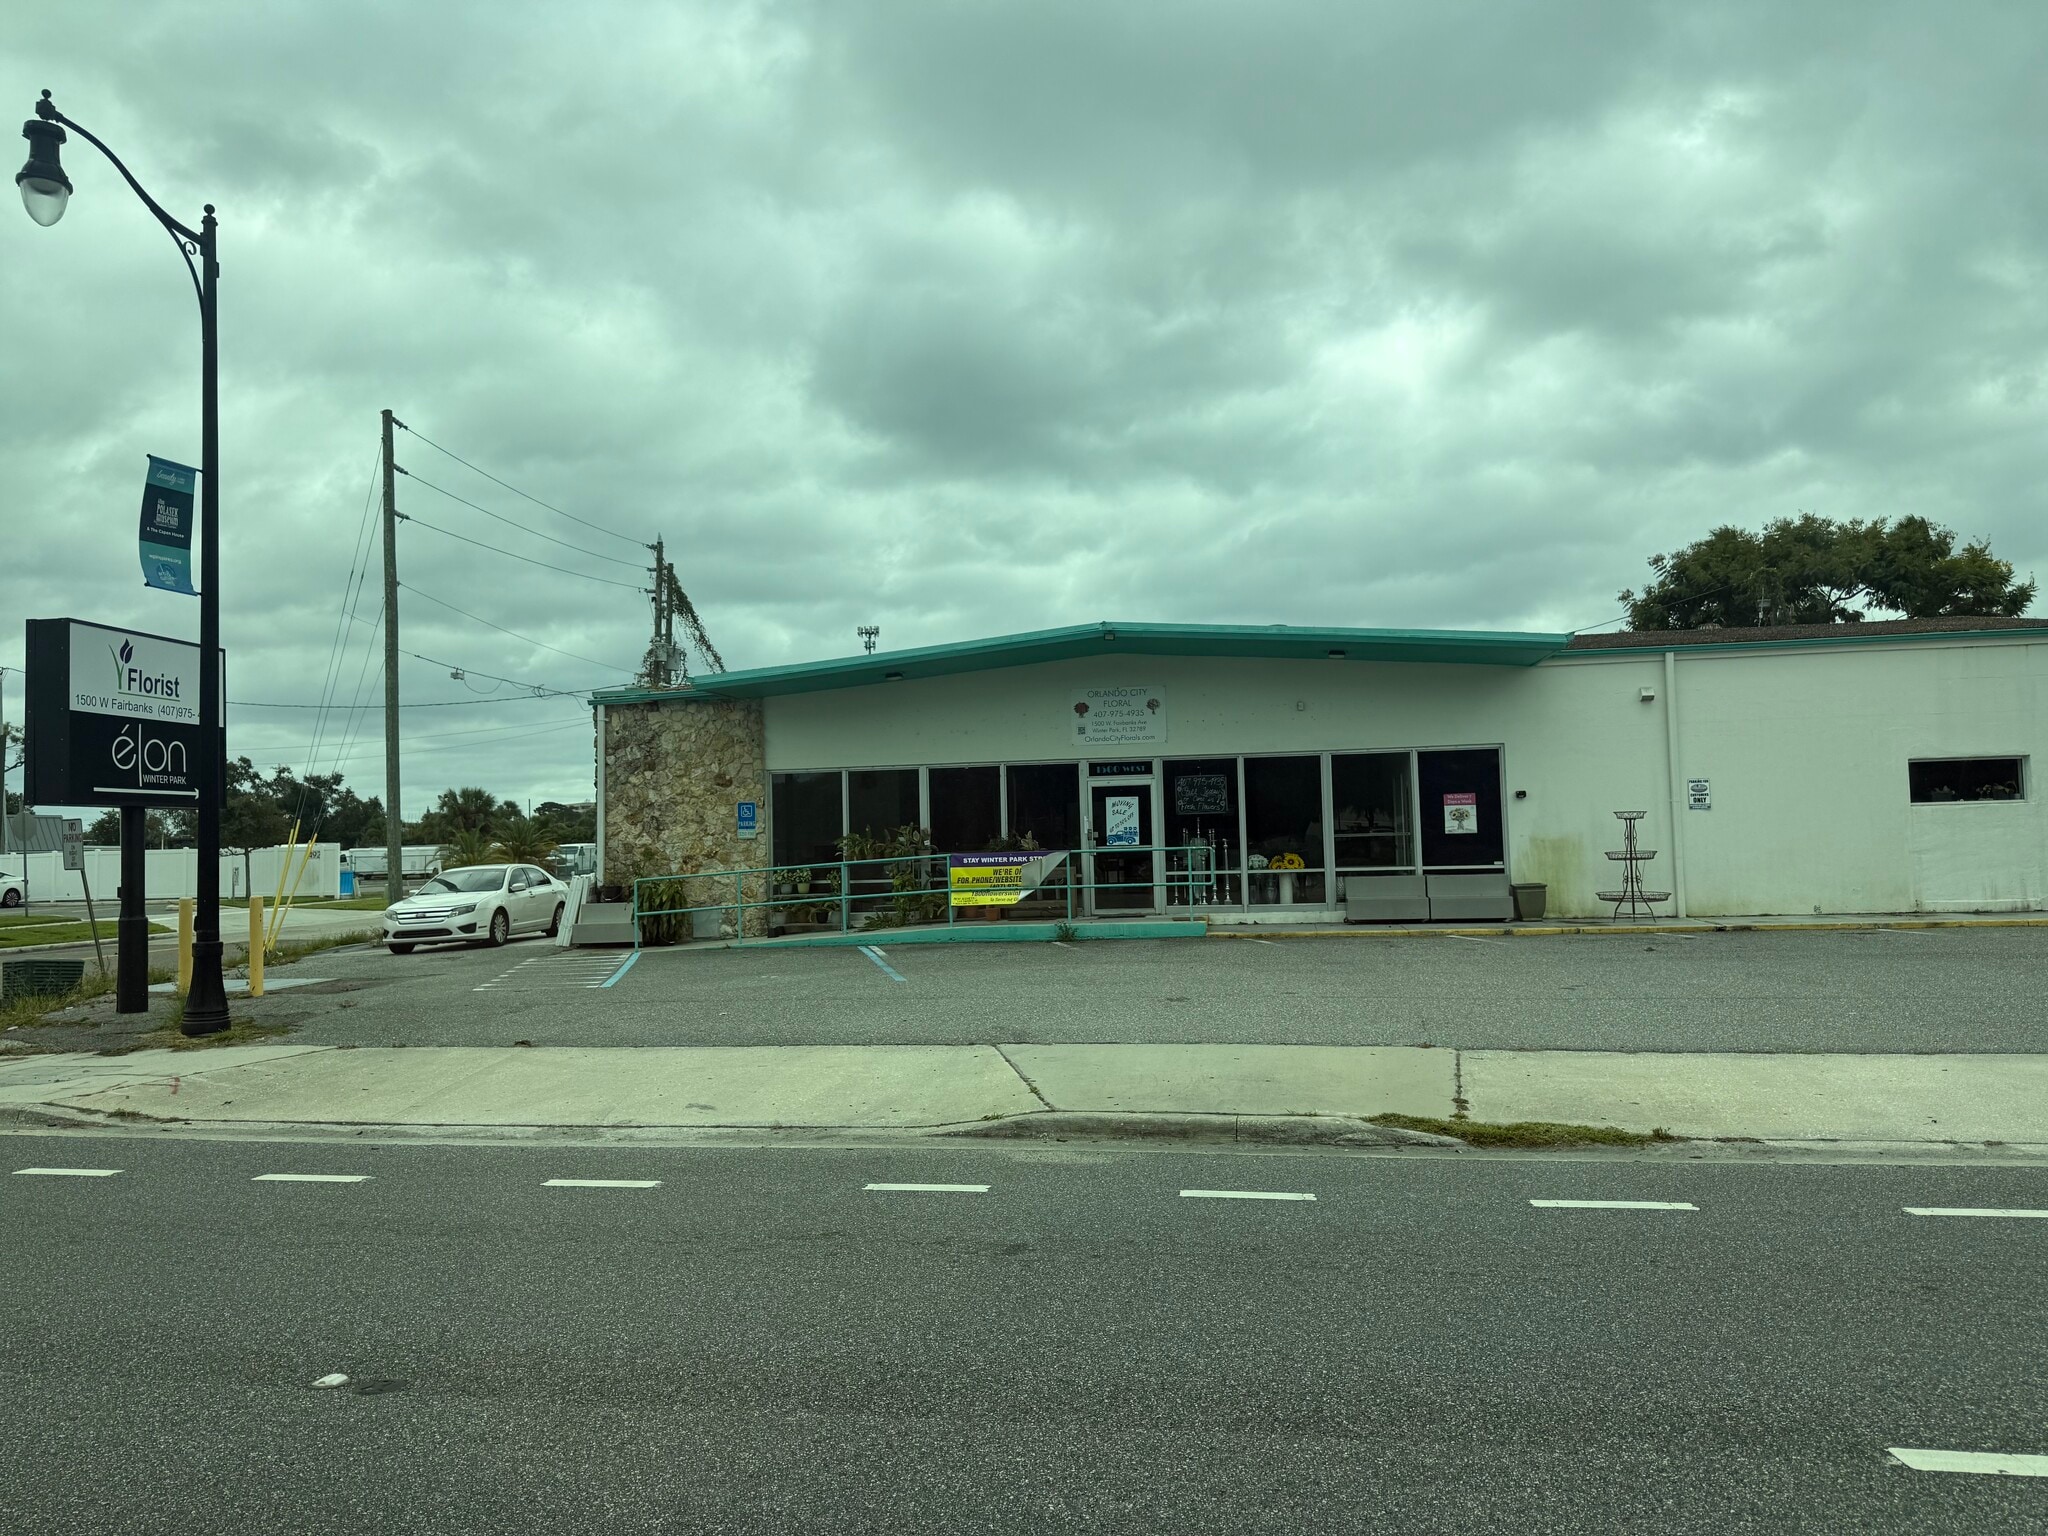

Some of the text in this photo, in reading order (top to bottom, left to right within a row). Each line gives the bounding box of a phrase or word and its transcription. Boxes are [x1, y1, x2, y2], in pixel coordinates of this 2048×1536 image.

[127, 667, 180, 698] Florist
[1087, 688, 1148, 698] ORLANDO CITY
[75, 694, 97, 707] 1500
[99, 696, 109, 709] W
[111, 698, 153, 714] Fairbanks
[1103, 699, 1132, 707] FLORAL
[1093, 709, 1145, 718] 407-975-4935
[1096, 765, 1119, 774] 1500
[143, 774, 187, 785] WINTER PARK
[992, 868, 1013, 876] WE'RE
[956, 875, 1022, 884] FOR PHONE/WEBSITE
